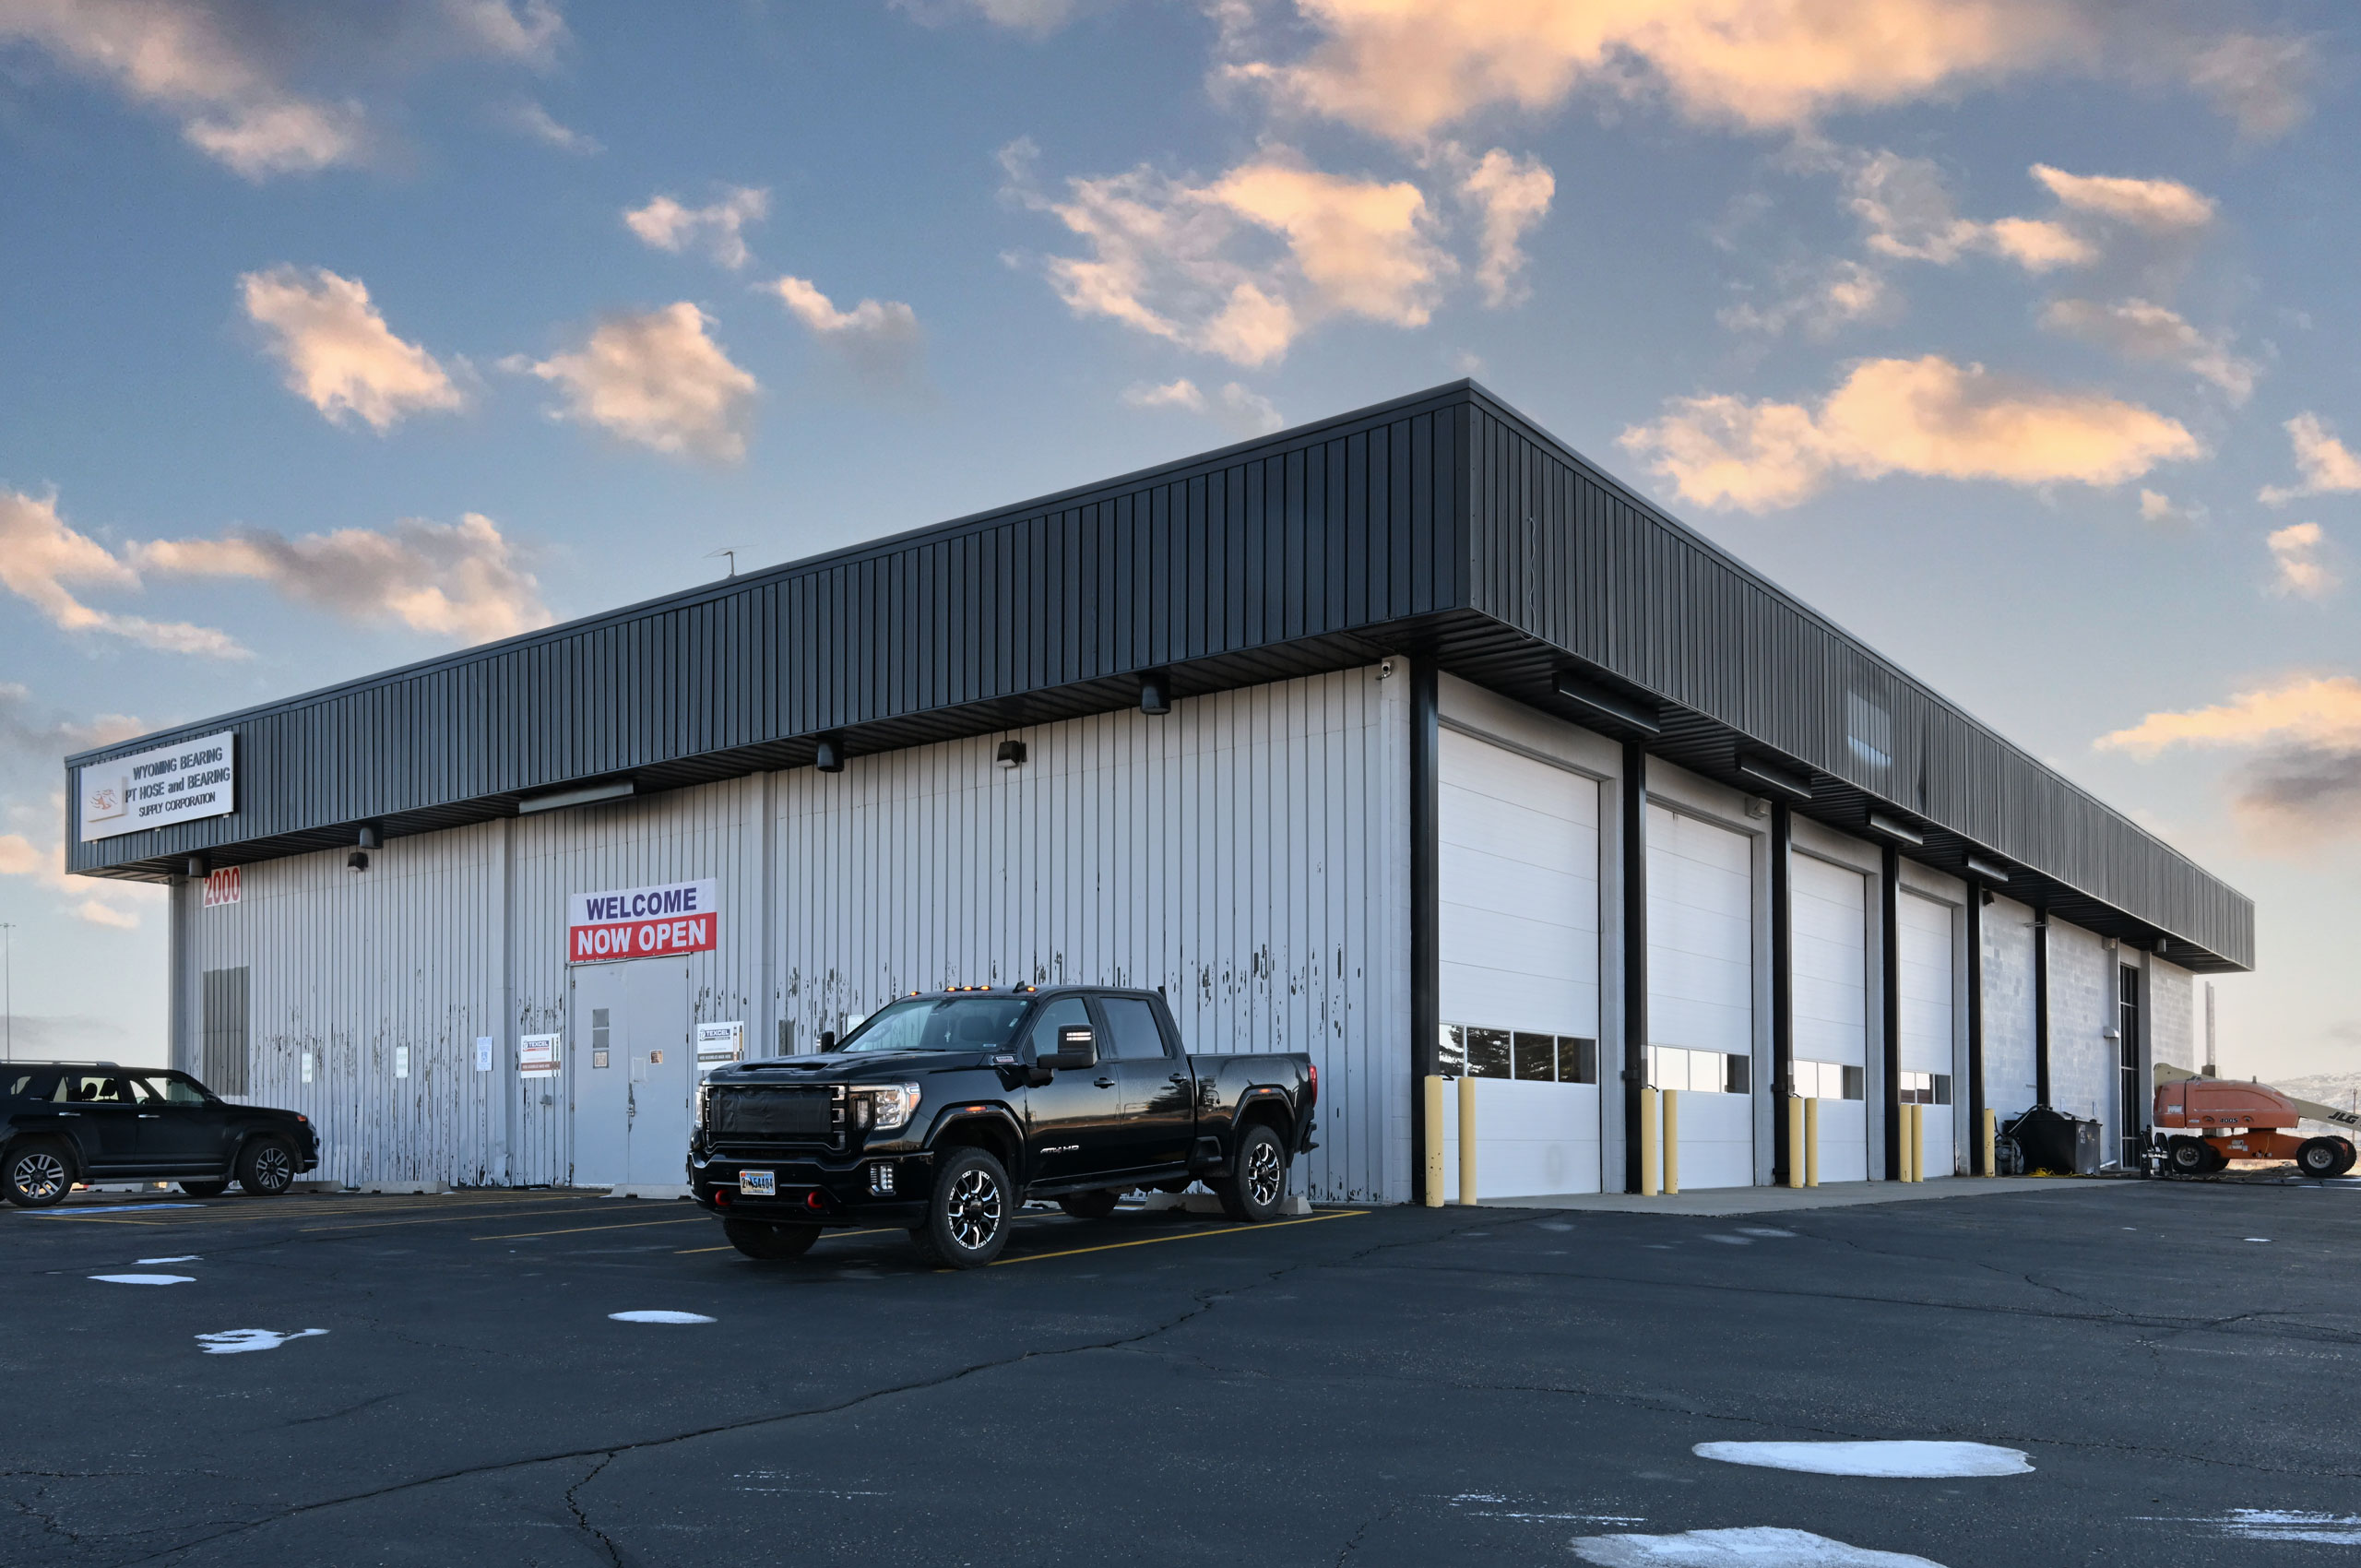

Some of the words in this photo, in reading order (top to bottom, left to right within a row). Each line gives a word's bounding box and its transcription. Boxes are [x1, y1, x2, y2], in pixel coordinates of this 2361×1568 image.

[133, 758, 177, 780] WYOMING
[180, 747, 222, 770] BEARING
[139, 781, 164, 801] HOSE
[168, 778, 184, 794] and
[187, 767, 231, 790] BEARING
[138, 802, 162, 817] SUPPLY
[165, 791, 216, 812] CORPORATION
[204, 867, 240, 906] 2000
[587, 887, 697, 921] WELCOME
[577, 927, 632, 956] NOW
[638, 919, 706, 951] OPEN
[2327, 1111, 2359, 1124] JLG
